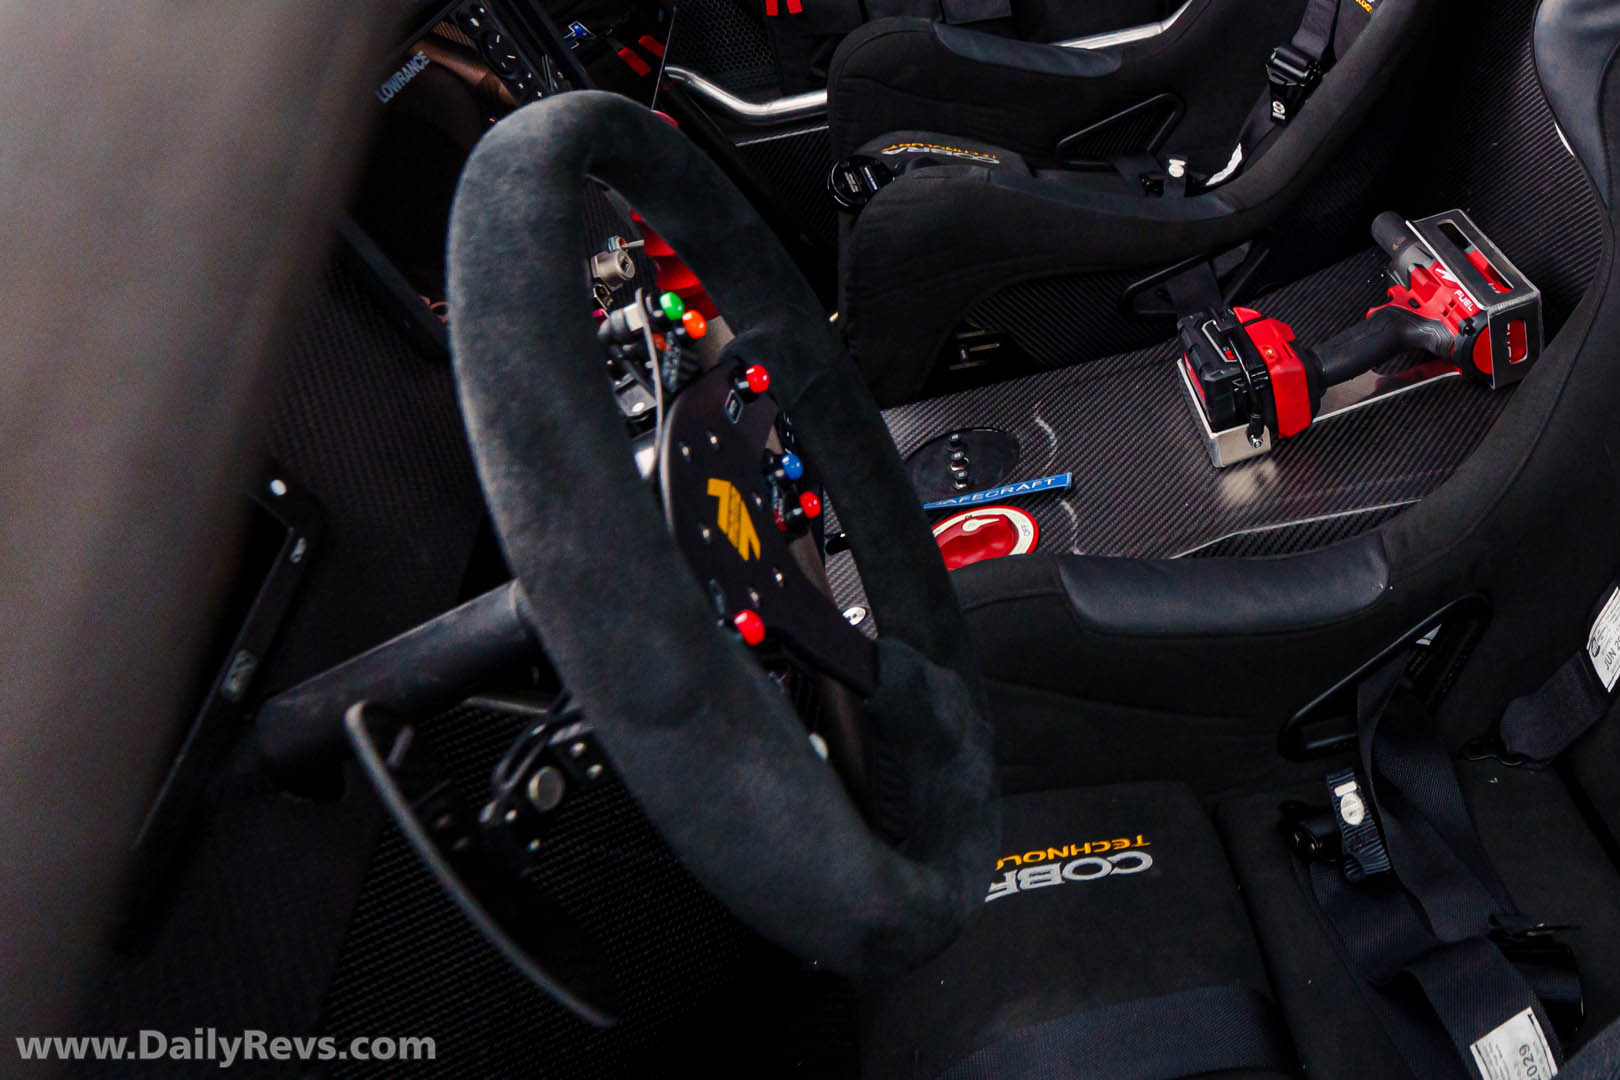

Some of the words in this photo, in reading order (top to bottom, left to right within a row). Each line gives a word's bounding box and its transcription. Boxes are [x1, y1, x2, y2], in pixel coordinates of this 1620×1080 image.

[376, 50, 430, 104] LOWRANCE
[1454, 289, 1474, 312] FUEL
[995, 834, 1151, 871] TECHNOL
[984, 850, 1153, 903] COBR
